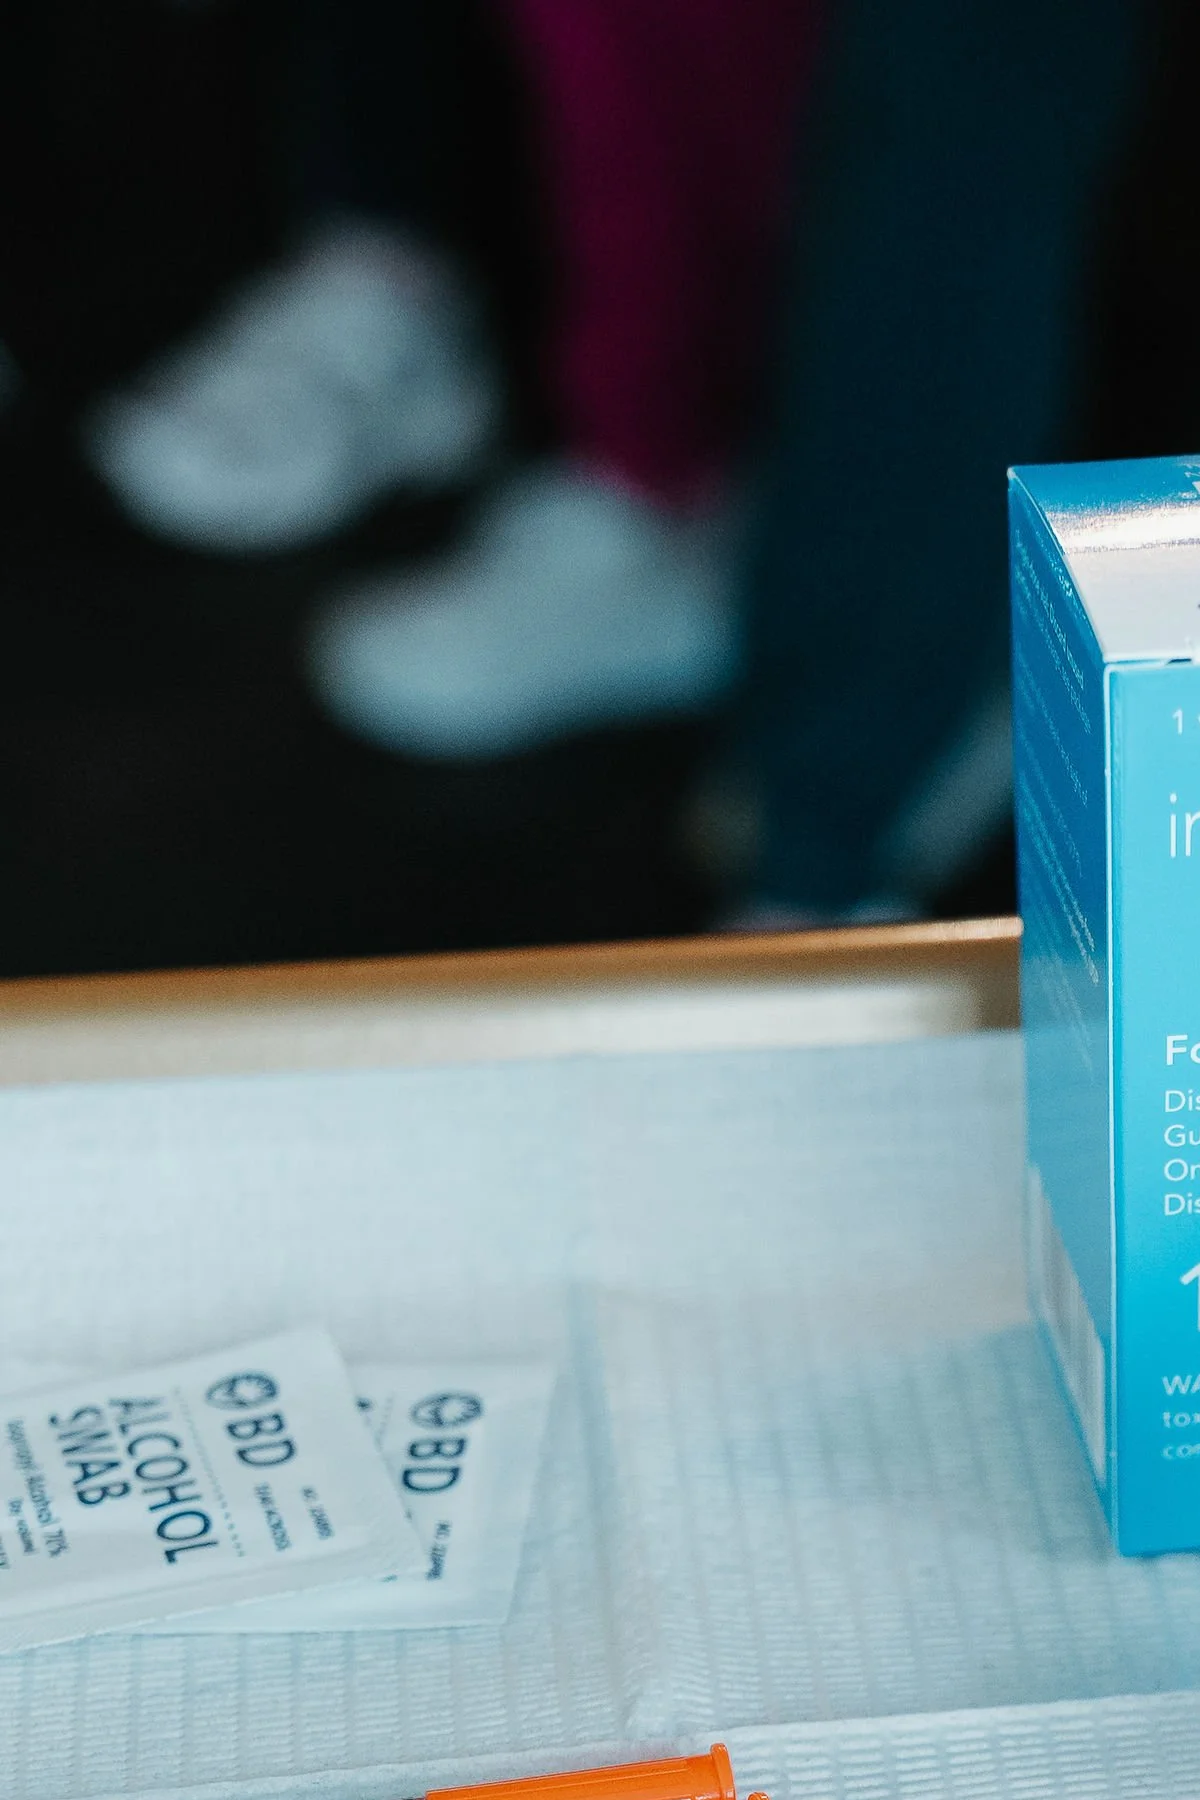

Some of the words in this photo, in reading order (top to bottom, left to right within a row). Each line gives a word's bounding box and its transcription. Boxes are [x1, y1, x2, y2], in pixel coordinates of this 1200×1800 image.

[1172, 708, 1184, 734] 1
[49, 1405, 132, 1508] SWAB
[227, 1411, 297, 1470] BD
[402, 1435, 468, 1495] BD
[109, 1395, 220, 1566] ALCOHOL
